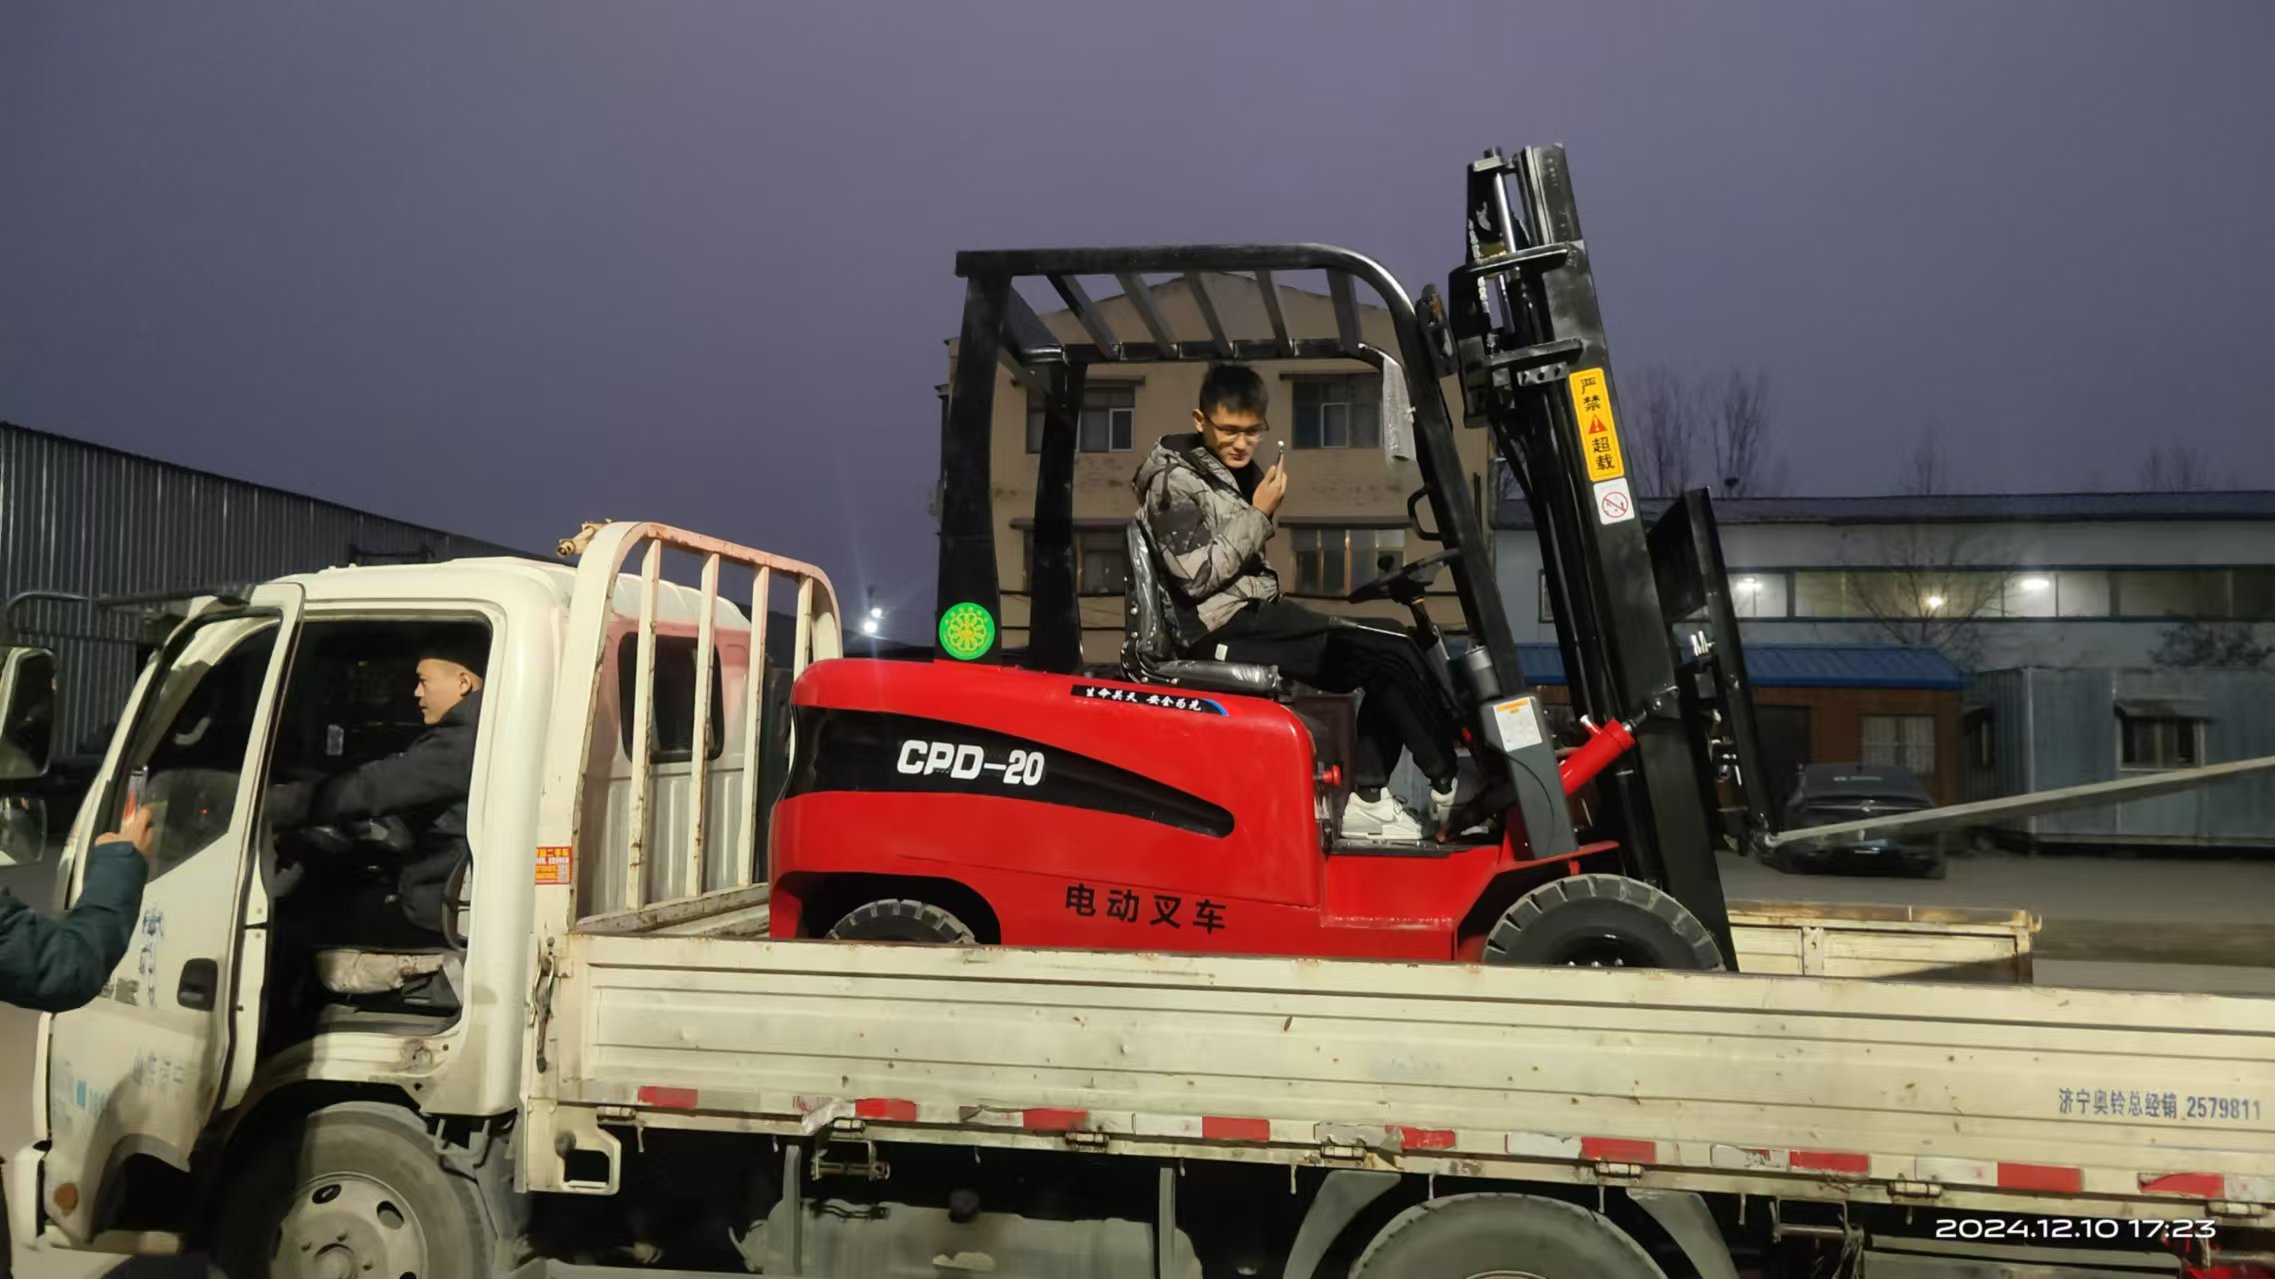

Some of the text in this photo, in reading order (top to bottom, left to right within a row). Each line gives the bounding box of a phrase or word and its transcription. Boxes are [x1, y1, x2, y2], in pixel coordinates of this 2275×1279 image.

[1580, 378, 1615, 471] 严禁 超载
[897, 739, 1045, 786] CPD-20
[1065, 883, 1226, 934] 电动叉车
[2058, 1088, 2261, 1121] 济宁奥铃总经销 2579811
